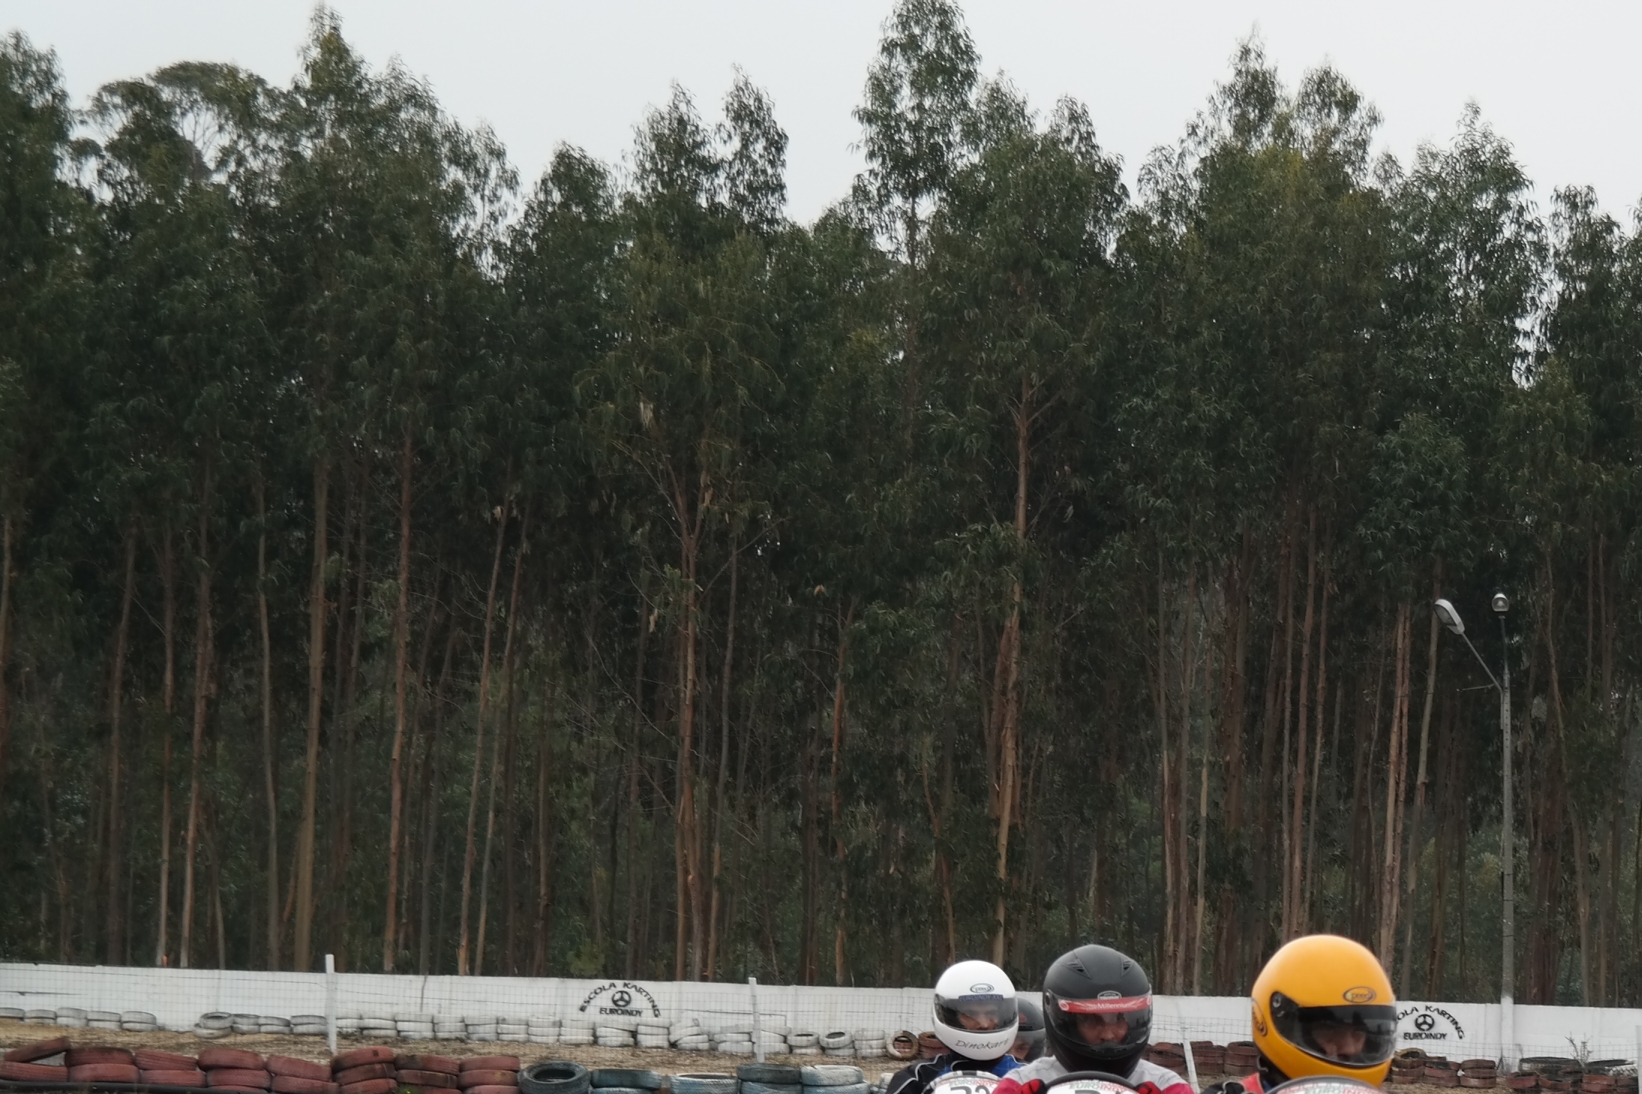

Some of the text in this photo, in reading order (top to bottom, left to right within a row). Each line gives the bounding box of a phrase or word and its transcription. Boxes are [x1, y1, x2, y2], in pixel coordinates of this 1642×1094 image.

[579, 982, 661, 1018] ESCOLA KARTING
[600, 1007, 643, 1017] EUROINDY
[1425, 1005, 1465, 1040] KARTING
[1403, 1032, 1447, 1040] EUROINDY
[955, 1039, 1009, 1050] Dinokart
